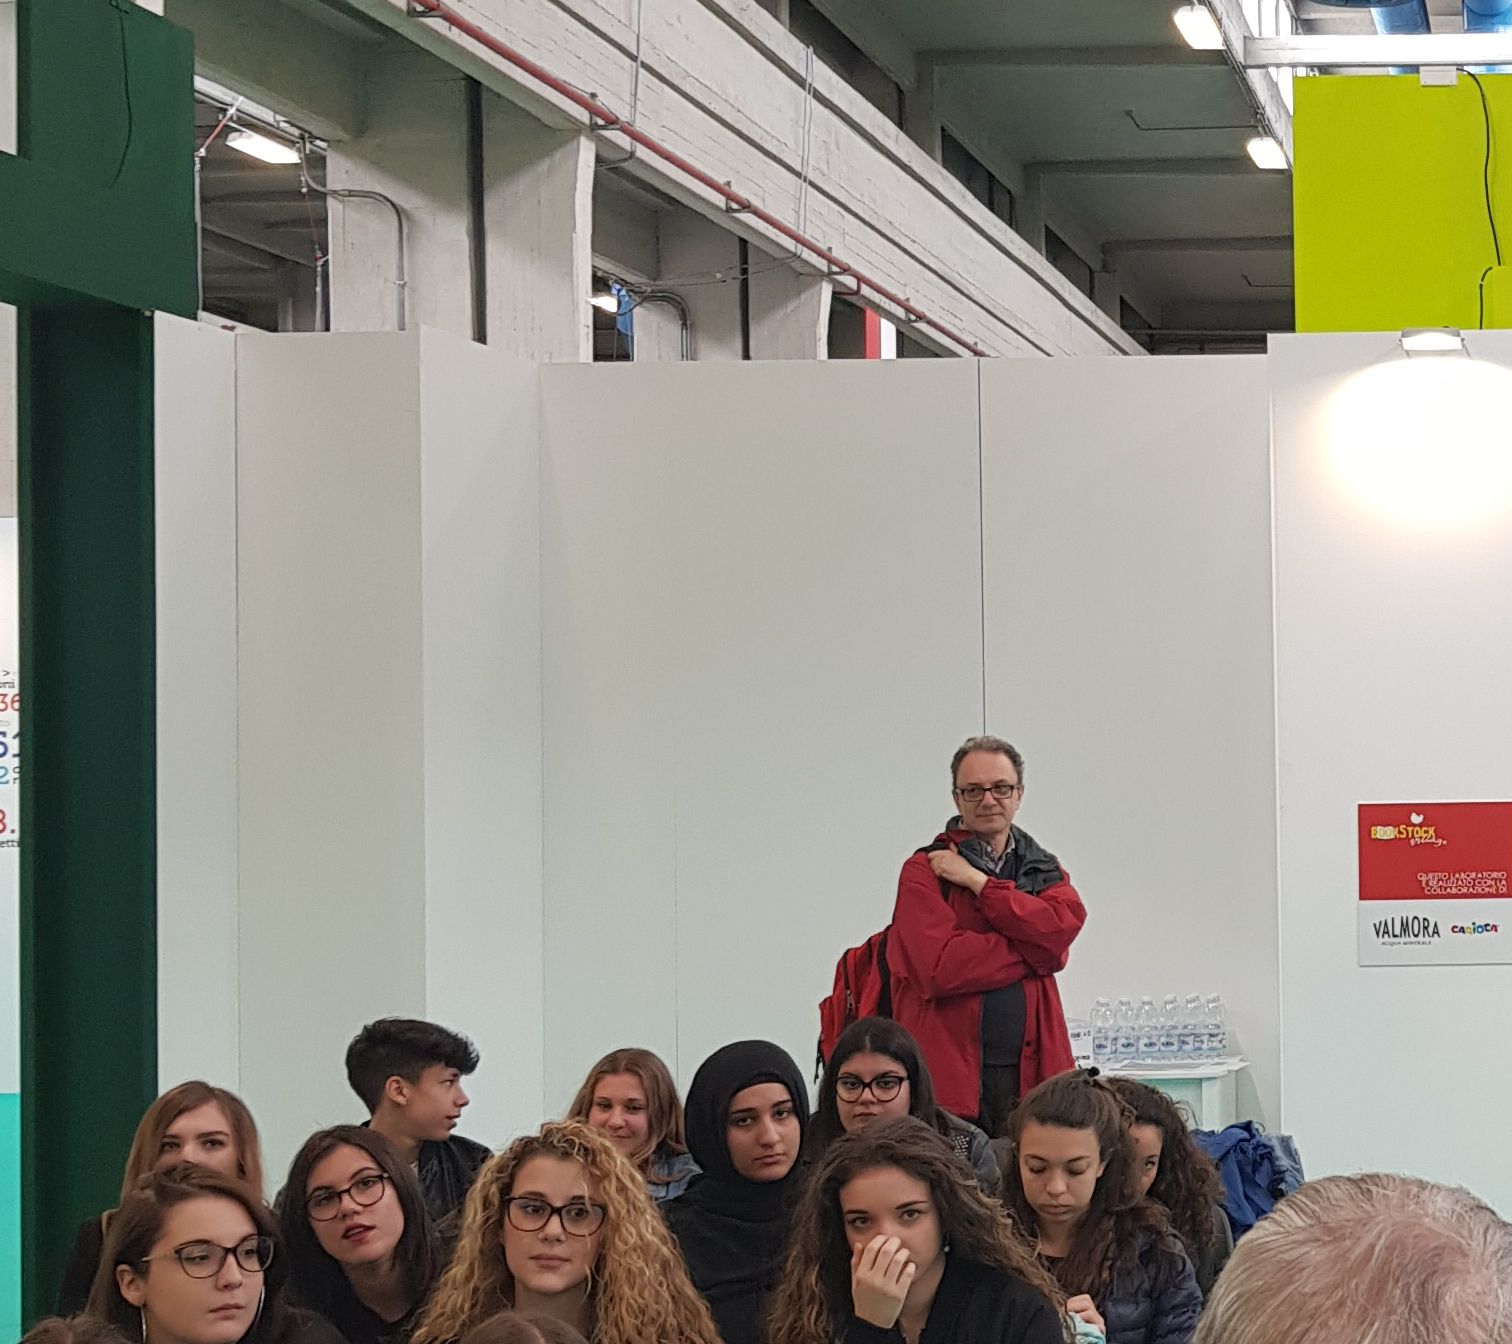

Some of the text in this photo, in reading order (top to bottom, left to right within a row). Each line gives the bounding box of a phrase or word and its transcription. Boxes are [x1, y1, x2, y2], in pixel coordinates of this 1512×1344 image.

[1417, 871, 1508, 881] QUESTO LABORATORIO
[1428, 878, 1474, 887] REALIZZATO
[1475, 878, 1495, 887] CON
[1424, 886, 1498, 895] COLLABORAZIONE
[1373, 915, 1441, 938] VALMORA
